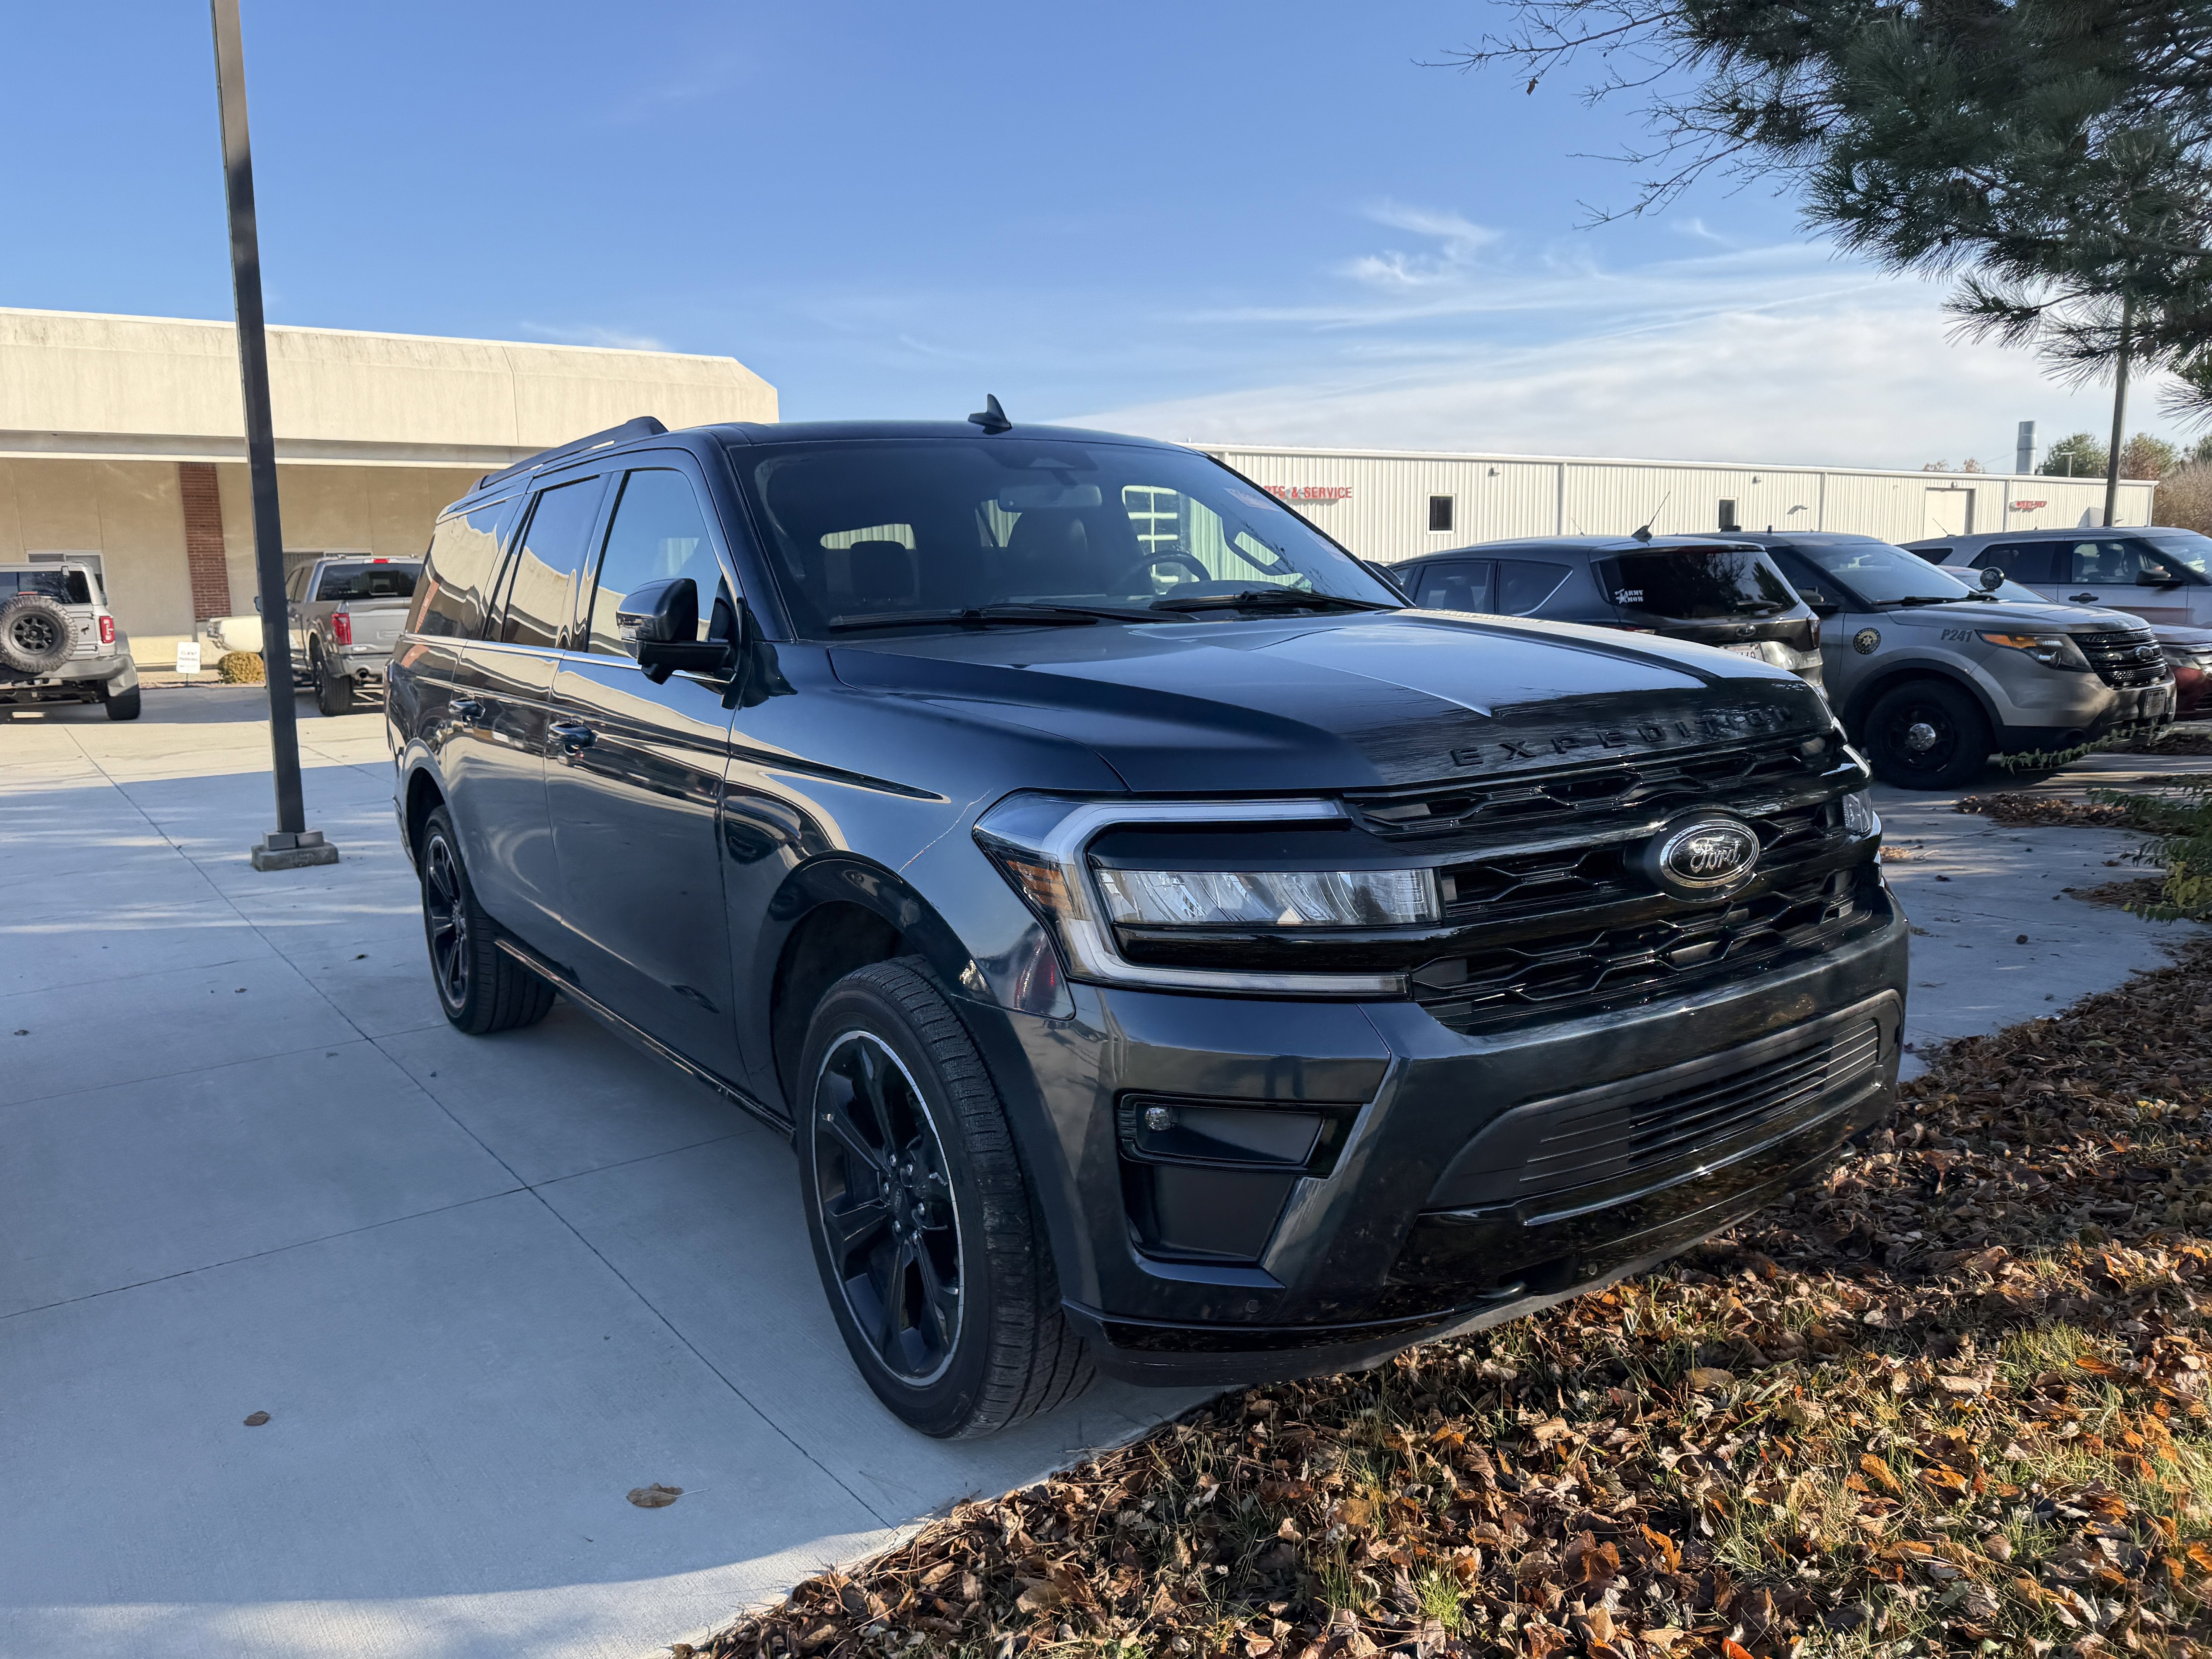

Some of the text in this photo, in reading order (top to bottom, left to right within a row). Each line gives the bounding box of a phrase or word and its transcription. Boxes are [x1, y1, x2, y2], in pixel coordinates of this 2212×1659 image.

[1291, 486, 1298, 498] &
[1304, 486, 1352, 498] SERVICE
[1941, 629, 1973, 642] P241
[1450, 706, 1794, 767] EXPEDITION
[1690, 834, 1741, 874] Ford
